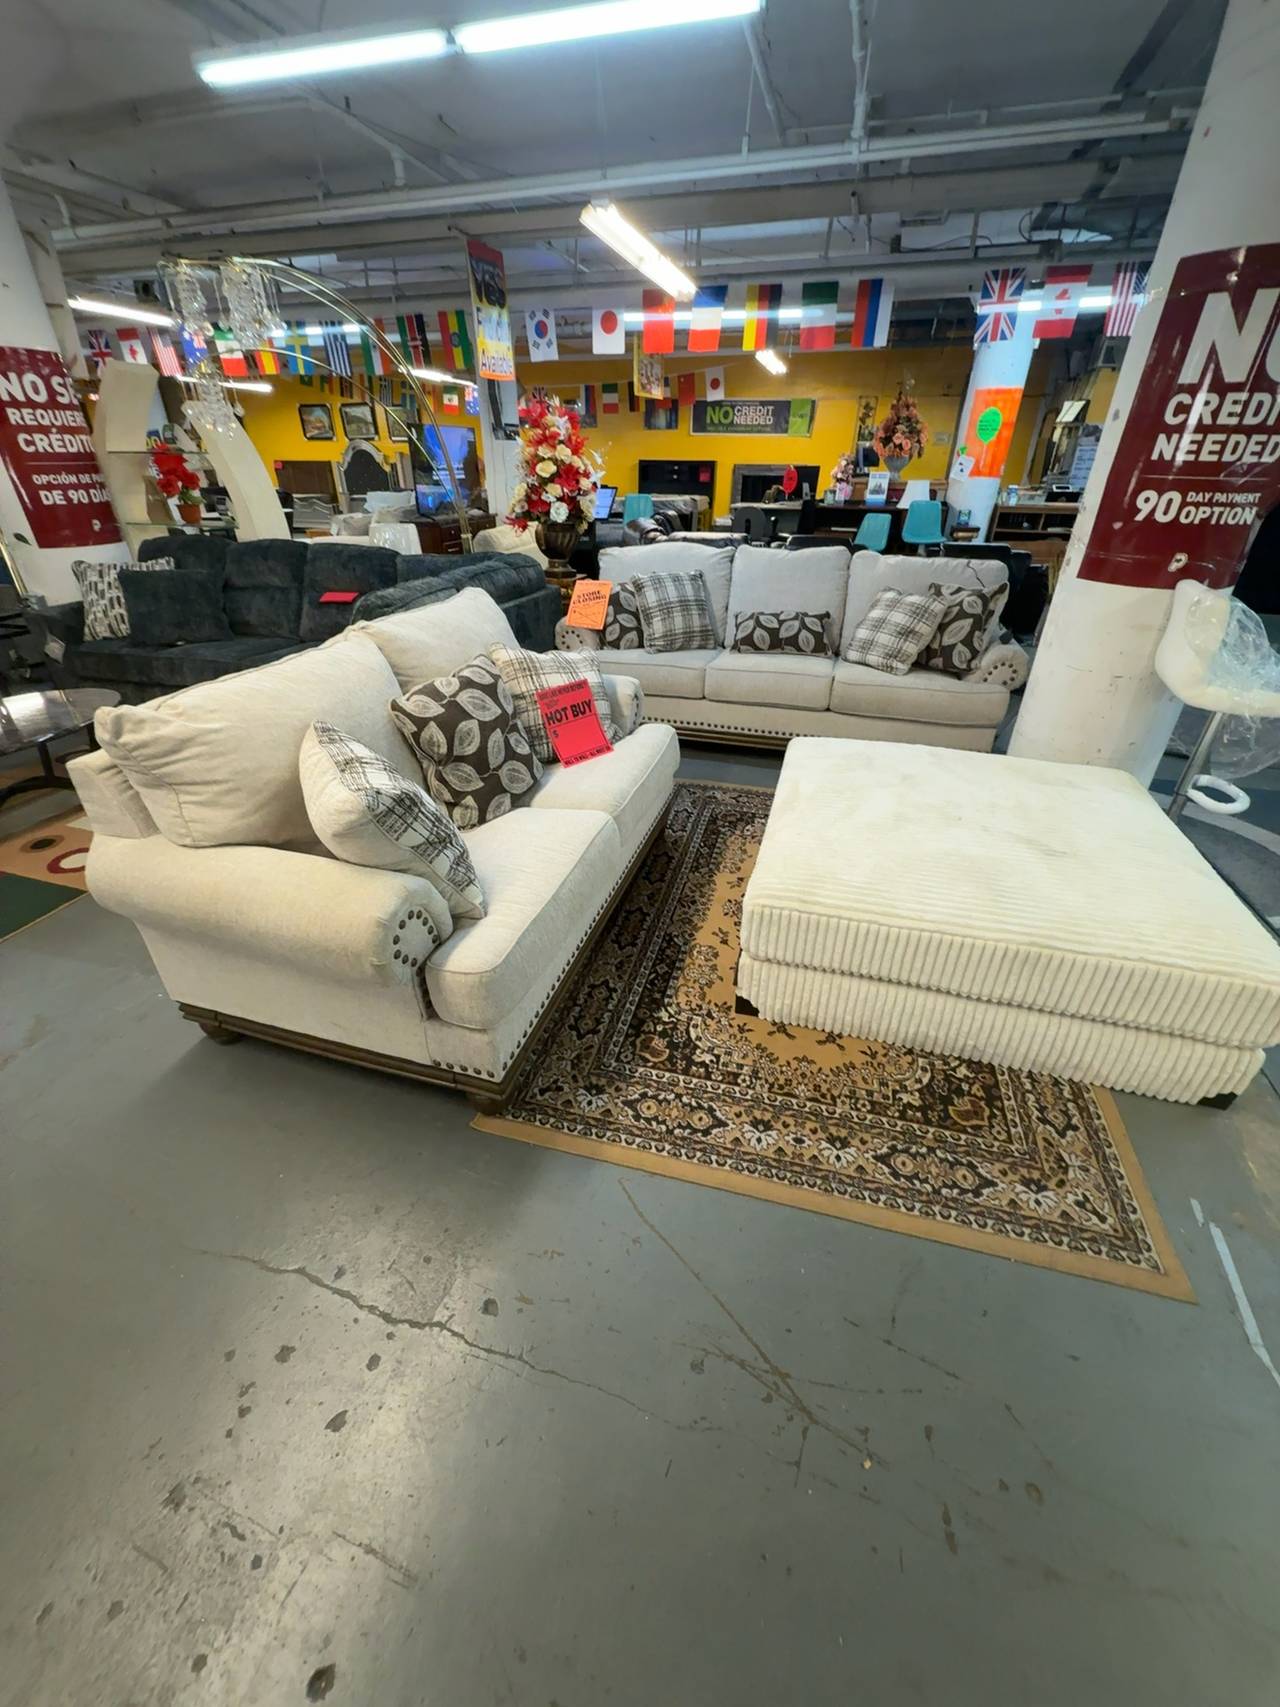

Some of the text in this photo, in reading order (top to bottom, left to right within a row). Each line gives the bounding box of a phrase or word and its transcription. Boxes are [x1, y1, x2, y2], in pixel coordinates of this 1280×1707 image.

[1177, 288, 1280, 384] N
[0, 371, 48, 404] NO
[706, 405, 774, 424] NO CREDIT
[733, 416, 773, 425] NEEDED
[1151, 433, 1280, 463] NEEDED
[32, 472, 78, 485] OPCIÓN
[79, 474, 92, 483] DE
[39, 490, 66, 505] DE
[68, 490, 89, 504] 90
[1134, 489, 1261, 523] 90 DAY PAYMENT
[1179, 505, 1258, 525] OPTION
[545, 706, 569, 726] HOT
[570, 699, 592, 718] BUY
